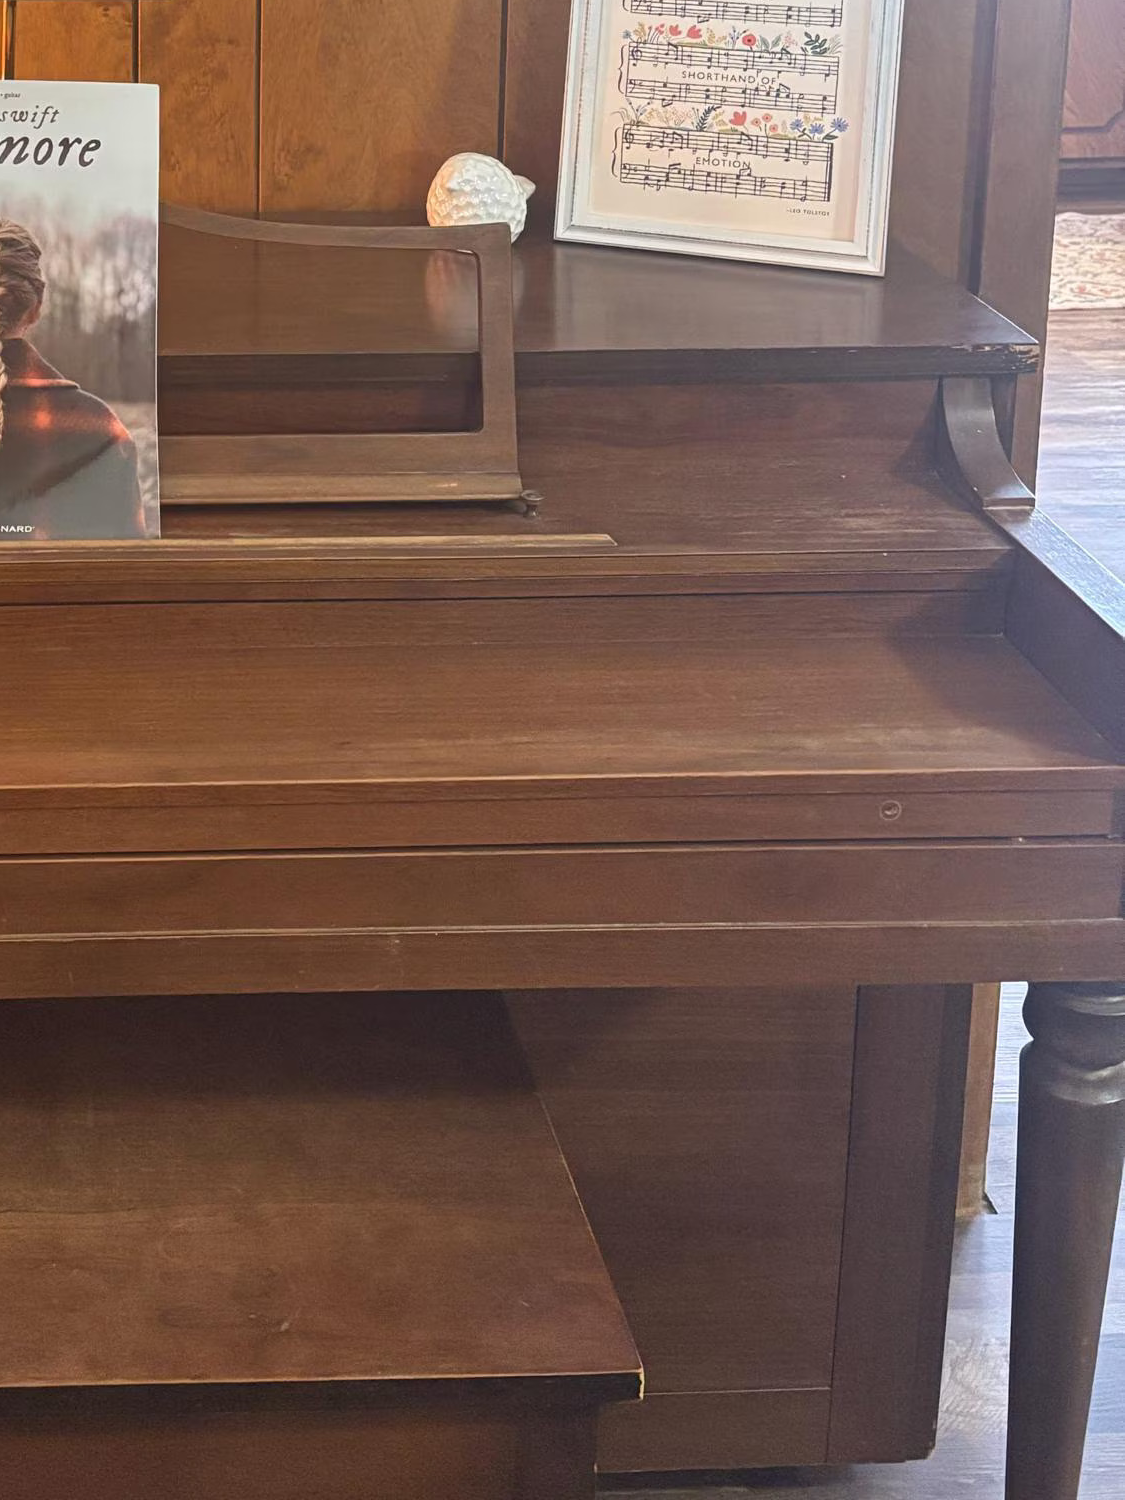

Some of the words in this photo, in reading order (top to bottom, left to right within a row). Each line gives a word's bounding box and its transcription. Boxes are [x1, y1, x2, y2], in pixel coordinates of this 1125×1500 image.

[682, 70, 756, 84] SHORTHAND
[761, 76, 776, 85] OF
[4, 91, 21, 99] guitar
[695, 157, 751, 169] EMOTION
